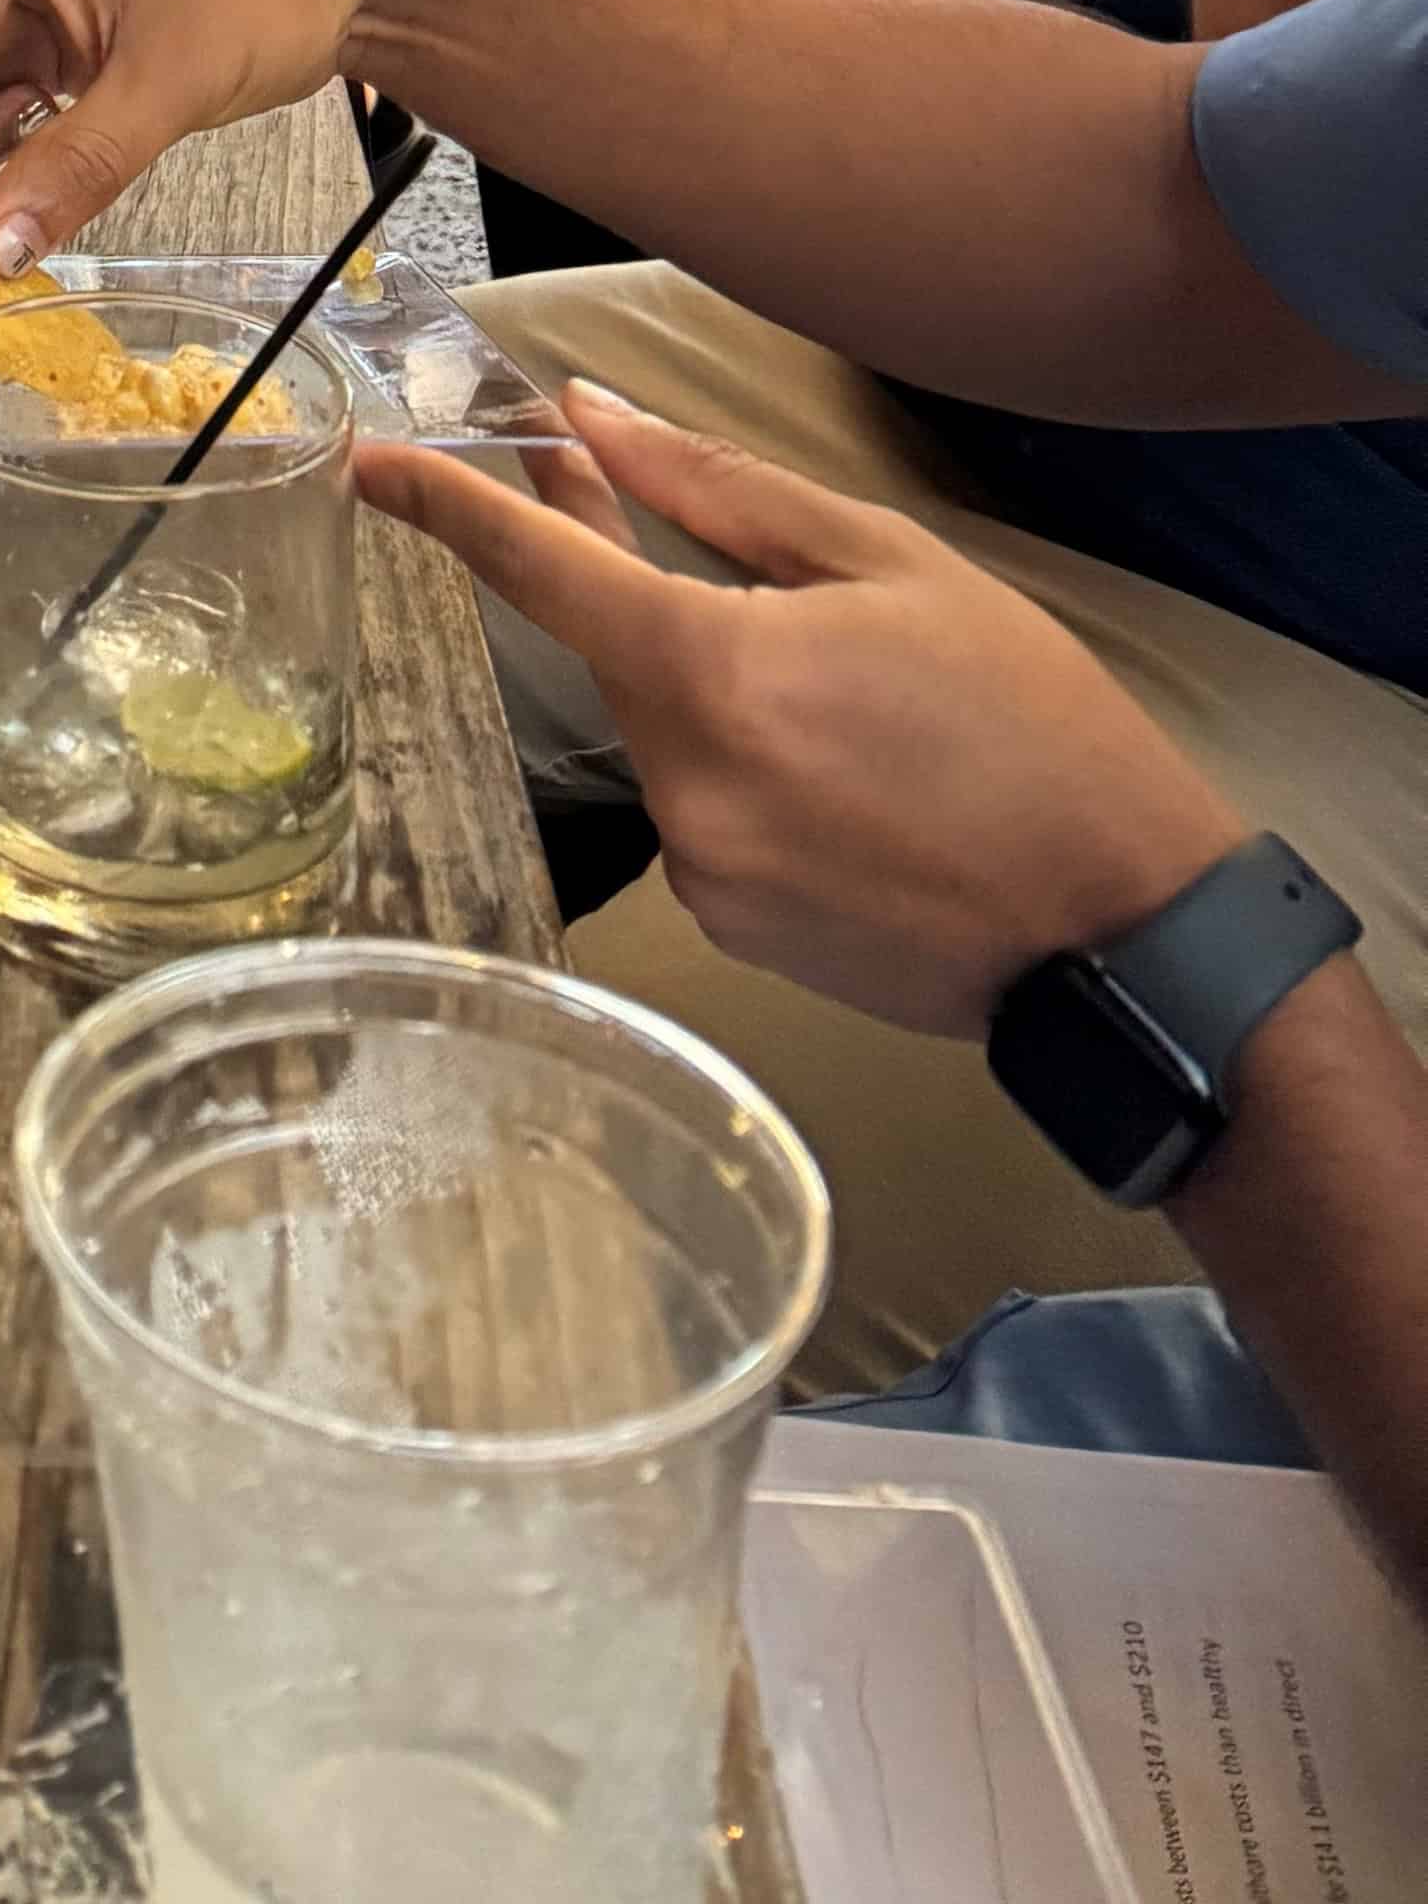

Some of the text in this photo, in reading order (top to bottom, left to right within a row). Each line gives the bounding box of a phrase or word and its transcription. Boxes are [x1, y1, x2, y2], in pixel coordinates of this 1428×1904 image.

[1199, 1638, 1231, 1721] healthy
[1275, 1659, 1305, 1722] direct
[1124, 1621, 1196, 1904] osts between $147 and $210
[1216, 1727, 1243, 1775] than
[1288, 1728, 1311, 1748] in
[1228, 1781, 1256, 1833] costs
[1297, 1754, 1328, 1818] billion
